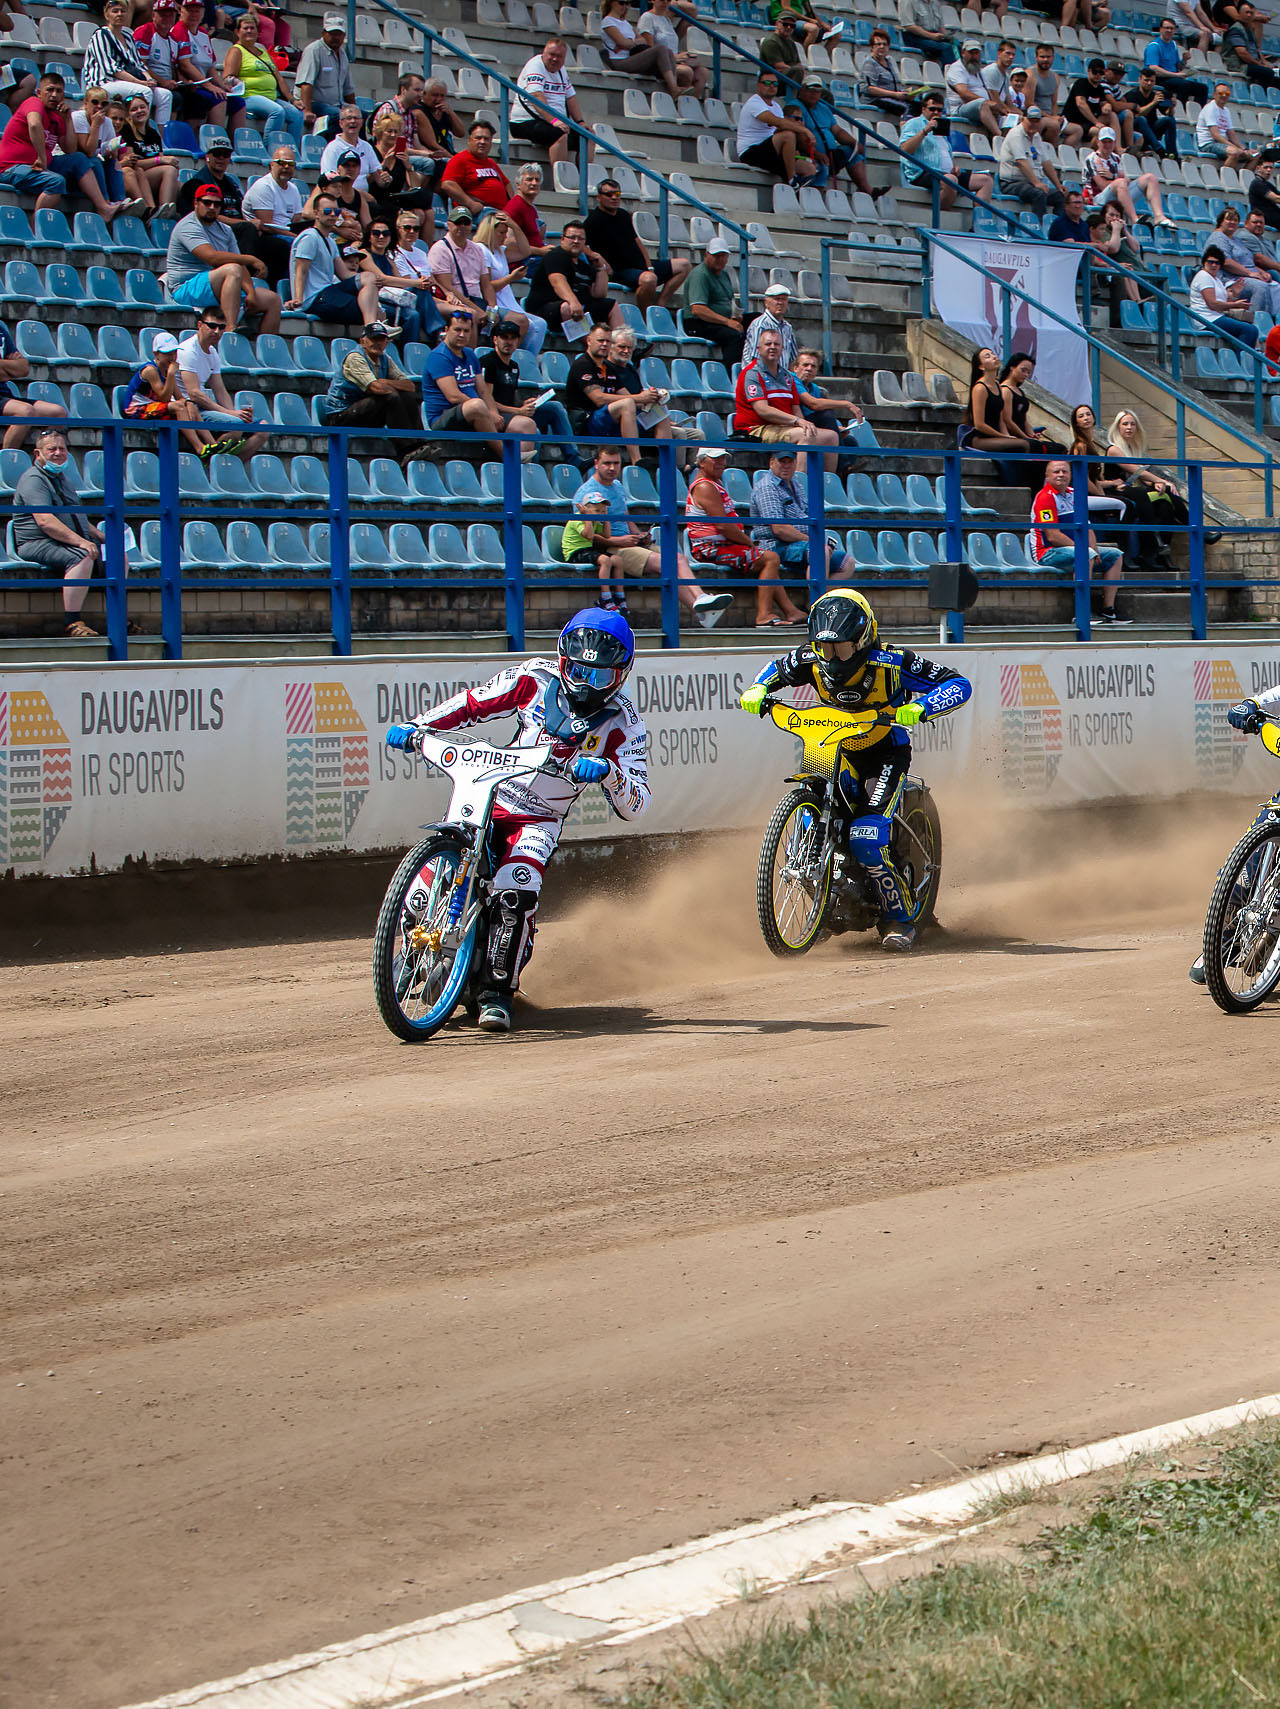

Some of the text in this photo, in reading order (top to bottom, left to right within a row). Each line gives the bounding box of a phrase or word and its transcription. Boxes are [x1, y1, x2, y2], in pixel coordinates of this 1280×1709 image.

[984, 251, 1030, 268] DAUGAVPILS
[636, 672, 744, 714] DAUGAVPILS
[1066, 664, 1155, 699] DAUGAVPILS
[81, 687, 224, 735] DAUGAVPILS
[377, 680, 492, 724] DAUGA
[803, 717, 859, 729] spechouse
[1069, 712, 1133, 747] IR SPORTS
[462, 748, 520, 766] OPTIBET
[659, 727, 718, 766] SPORTS
[82, 750, 185, 797] IR SPORTS
